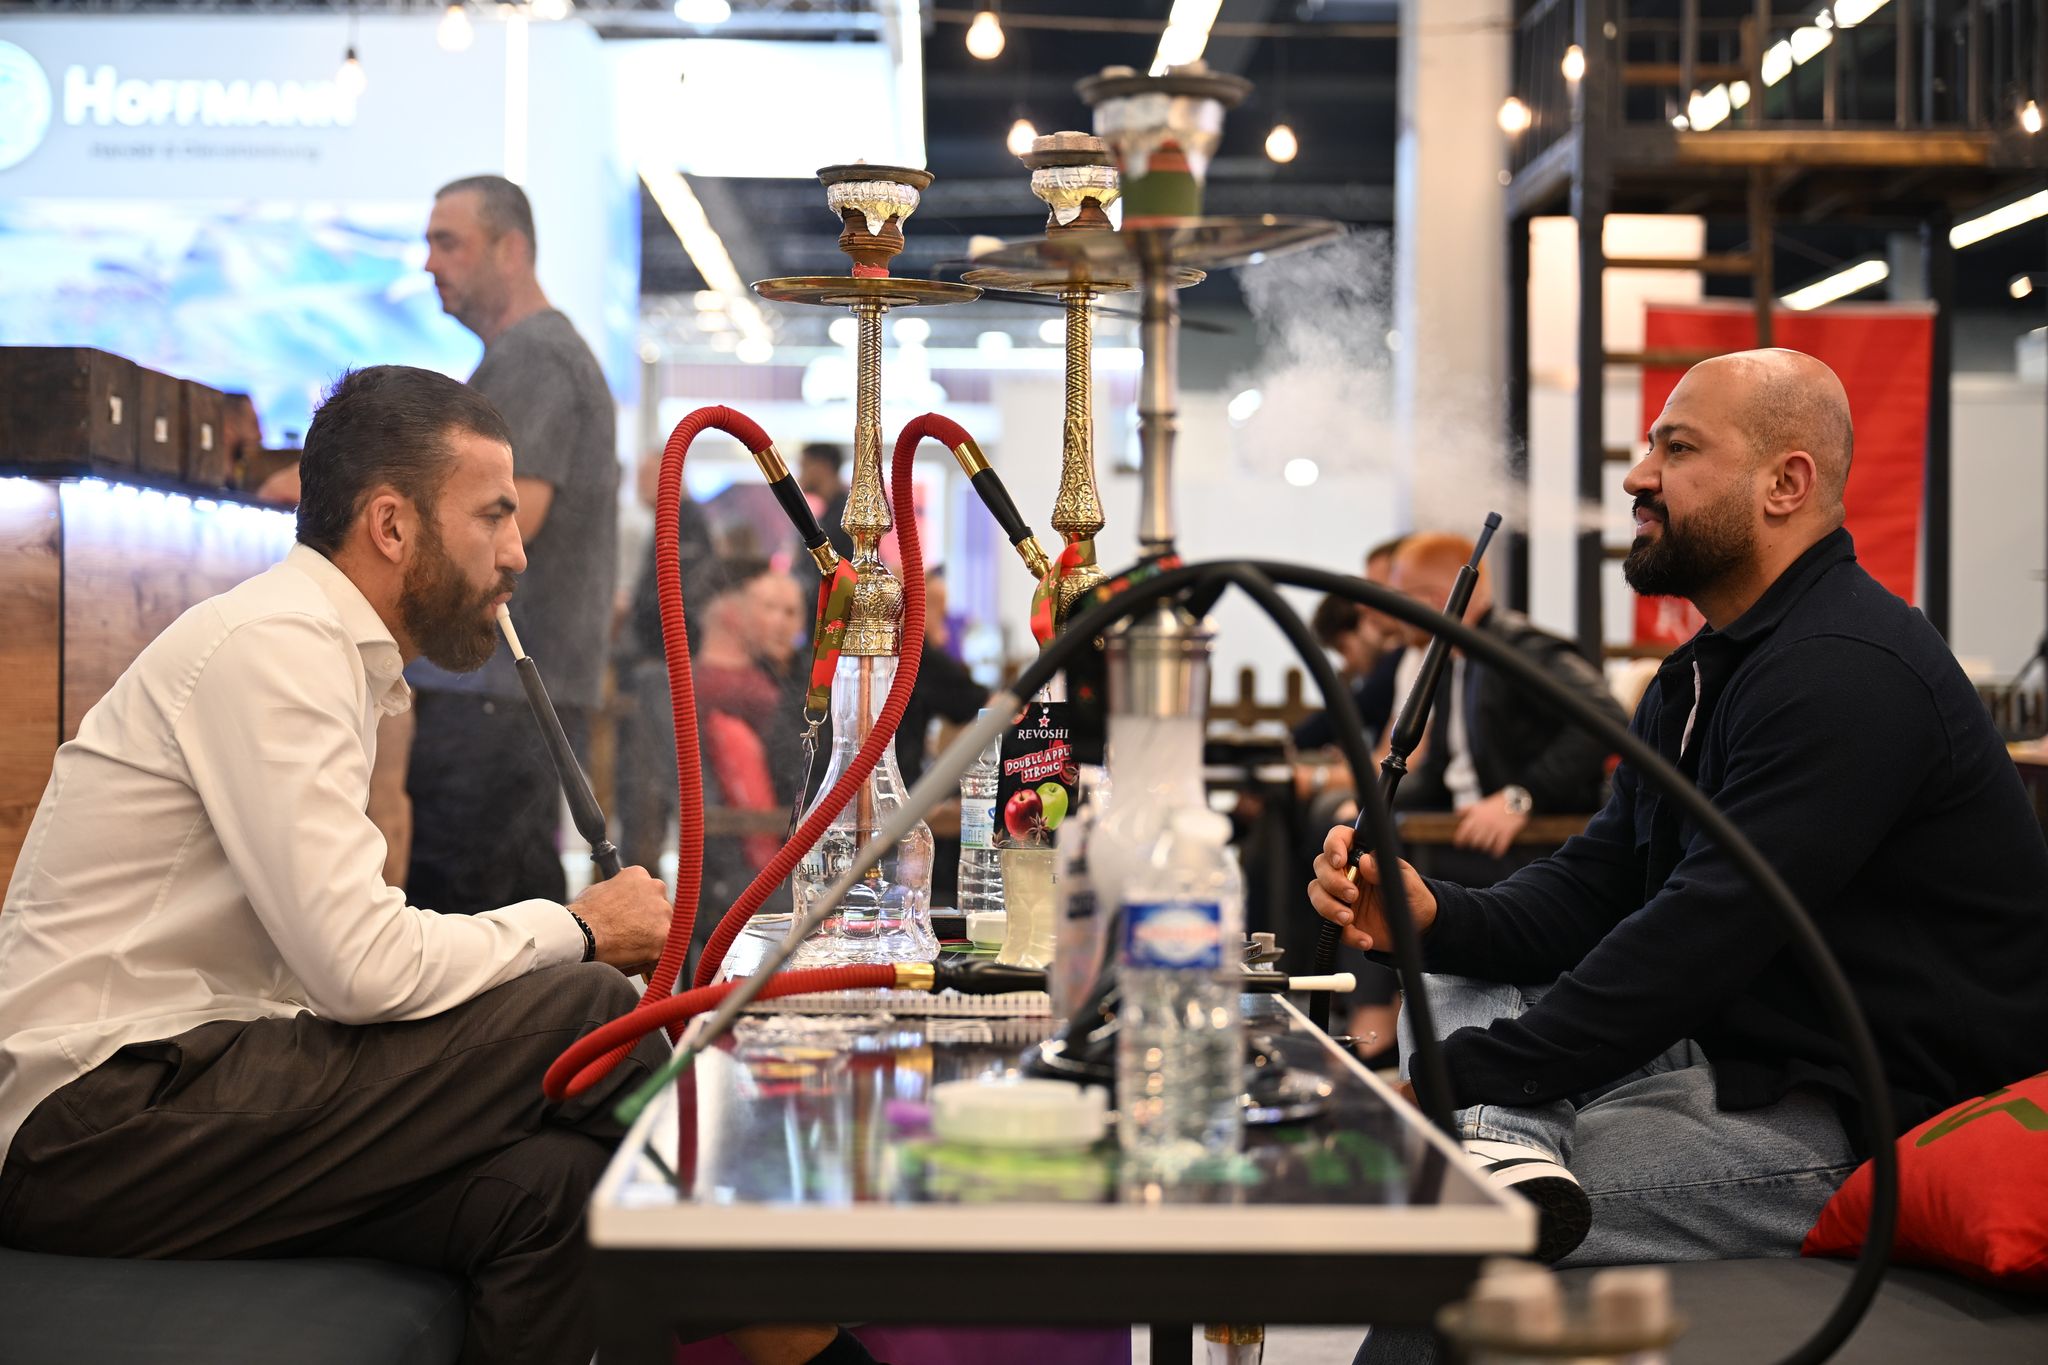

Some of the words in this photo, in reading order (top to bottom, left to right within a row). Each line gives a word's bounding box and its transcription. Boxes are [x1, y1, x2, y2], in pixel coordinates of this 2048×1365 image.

[1018, 729, 1069, 740] REVOSHI
[1006, 754, 1042, 772] DOUBLE
[1045, 748, 1072, 763] APPL
[1023, 762, 1060, 779] STRONG
